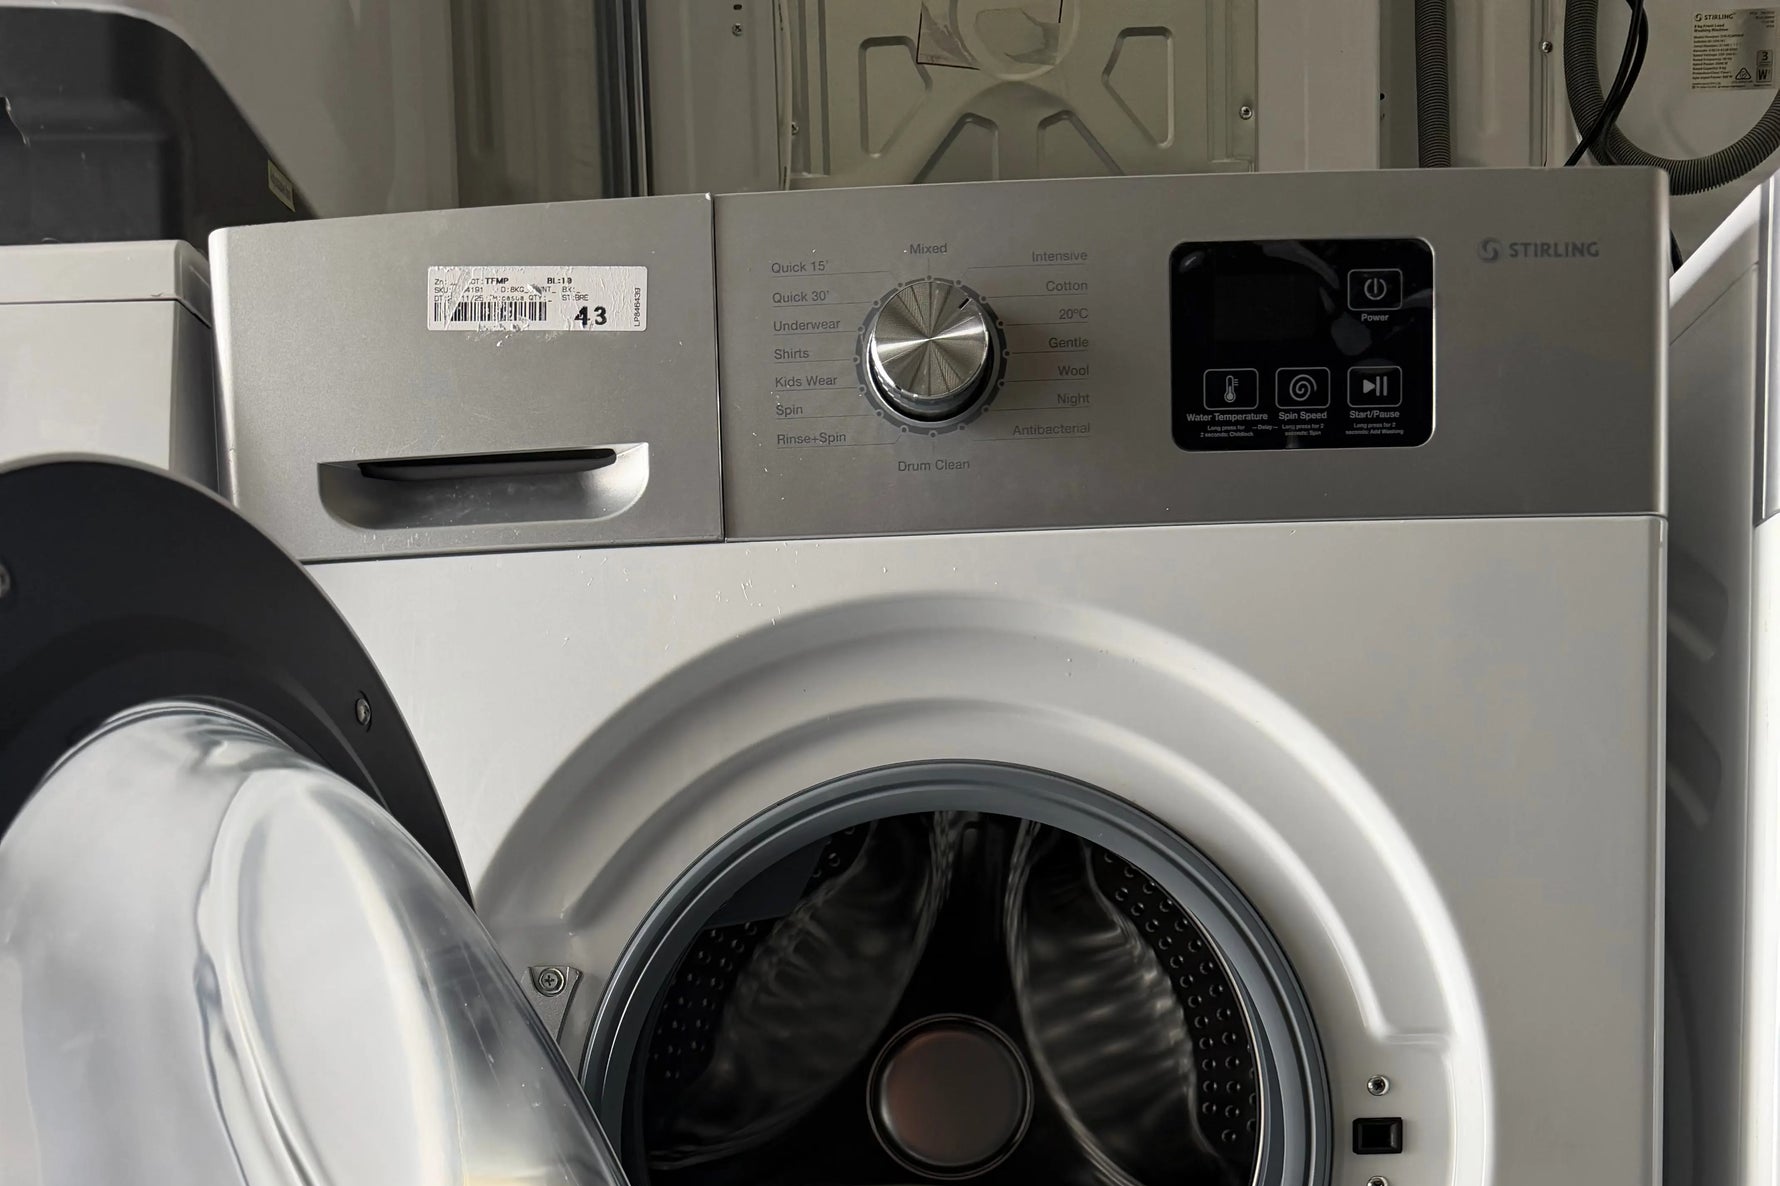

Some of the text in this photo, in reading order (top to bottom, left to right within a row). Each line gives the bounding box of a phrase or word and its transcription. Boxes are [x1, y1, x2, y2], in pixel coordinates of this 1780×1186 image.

[909, 242, 948, 255] Mixed
[1508, 241, 1600, 258] STIRLING
[1031, 251, 1089, 263] Intensive
[771, 262, 807, 274] Quick
[1046, 280, 1089, 292] Cotton
[772, 291, 808, 303] Quick
[574, 306, 607, 328] 43
[1058, 308, 1089, 320] 20°C
[1361, 313, 1389, 322] Power
[773, 319, 841, 332] Underwear
[1048, 337, 1089, 349] Gentle
[774, 348, 809, 360] Shirts
[1057, 365, 1090, 377] Wool
[775, 375, 838, 388] Kids Wear
[1057, 393, 1090, 406] Night
[776, 404, 804, 417] Spin
[1278, 411, 1328, 421] Spin Speed
[1349, 410, 1401, 419] Start/Pause
[1186, 412, 1269, 422] Water Temperature
[1012, 423, 1090, 436] Antibacterial
[777, 432, 847, 446] Rinse+Spin
[897, 459, 970, 472] Drum Clean
